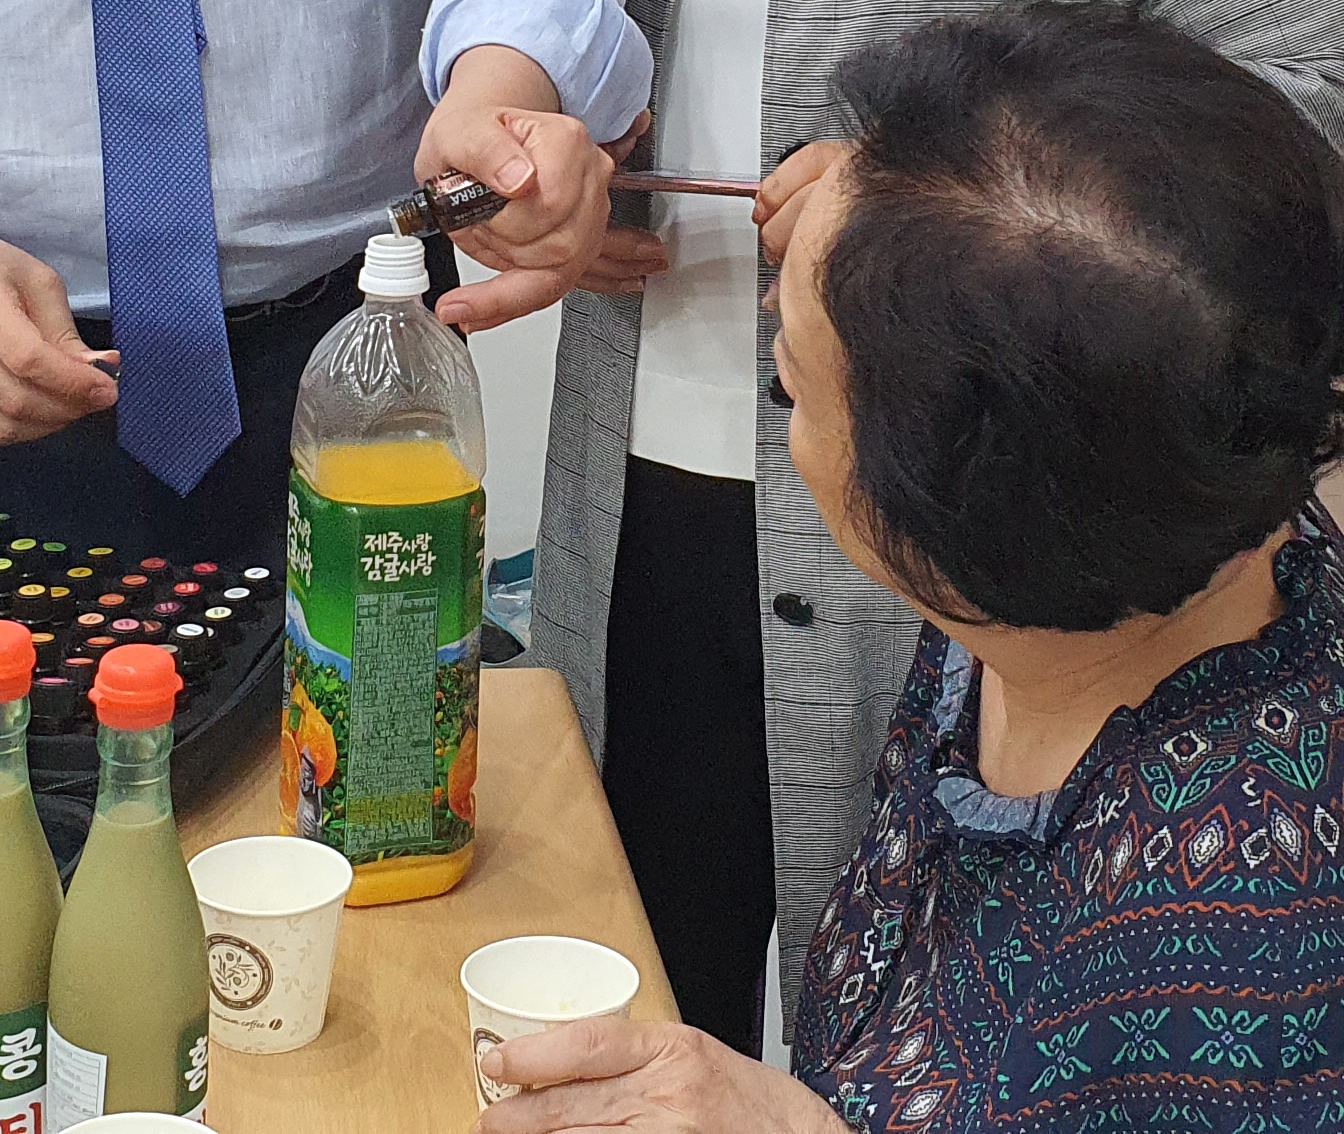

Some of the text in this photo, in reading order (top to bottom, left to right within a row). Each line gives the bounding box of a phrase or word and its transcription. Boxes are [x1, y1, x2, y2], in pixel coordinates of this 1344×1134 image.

[449, 184, 493, 207] TERRA
[363, 531, 433, 554] 제주사랑
[360, 550, 437, 583] 감귤사랑
